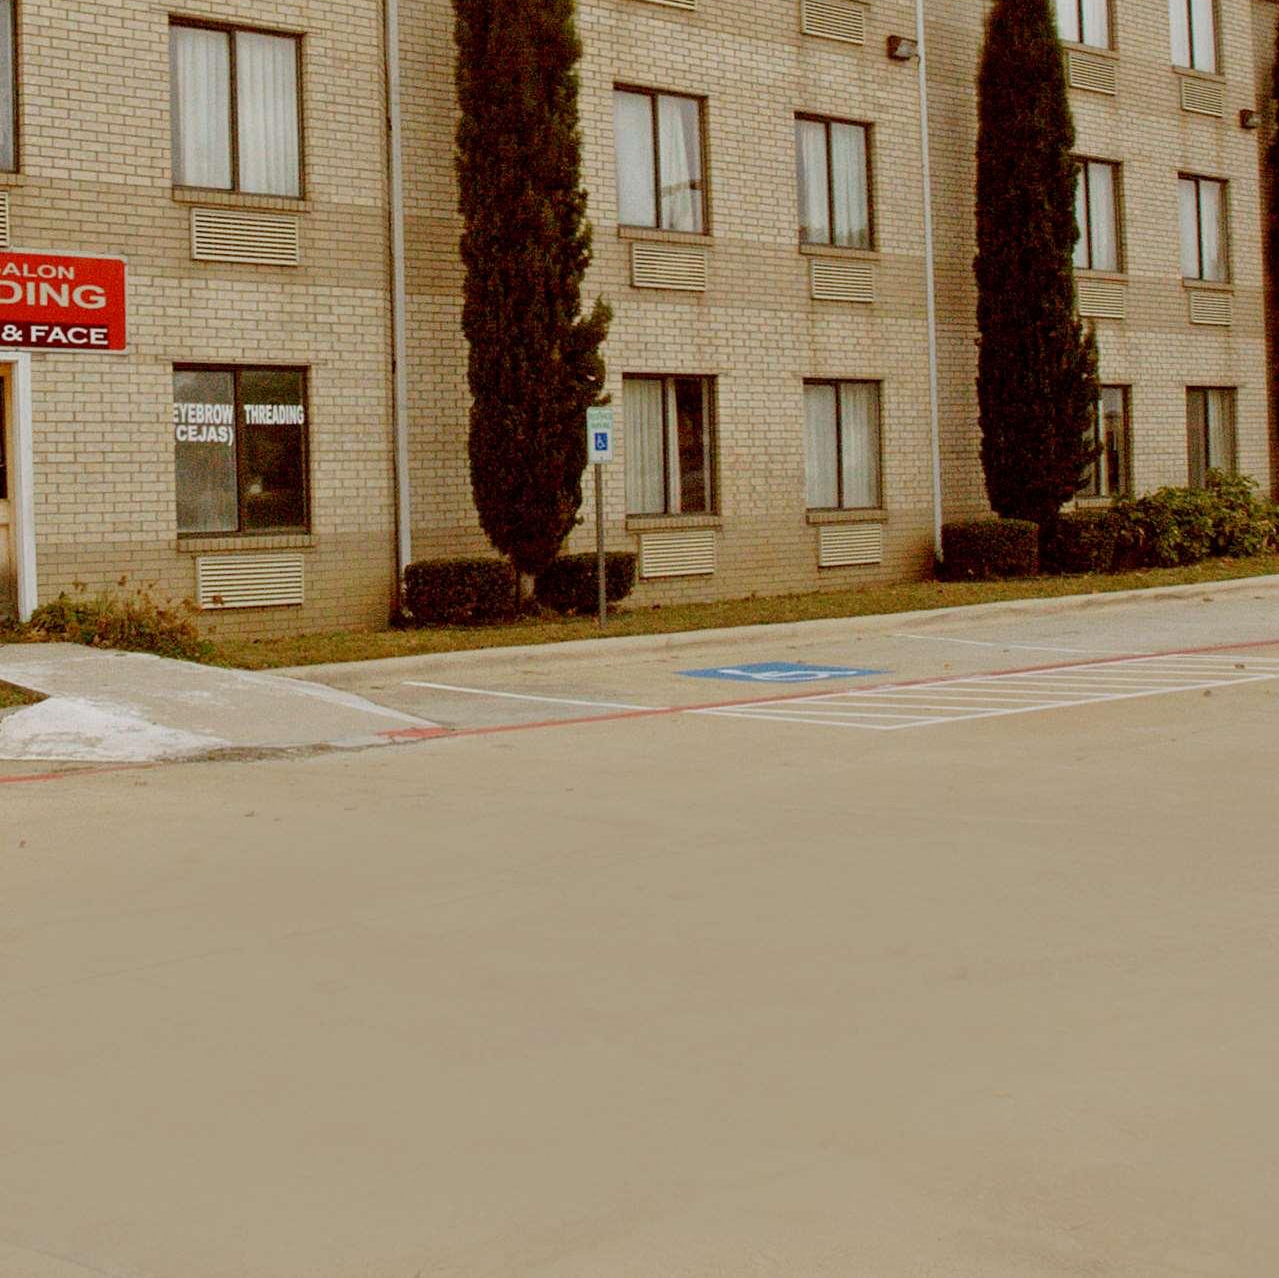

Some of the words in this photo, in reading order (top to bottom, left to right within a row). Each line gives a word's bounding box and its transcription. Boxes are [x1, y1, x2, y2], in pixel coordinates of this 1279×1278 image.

[2, 324, 22, 341] &
[31, 326, 107, 345] FACE
[173, 403, 233, 424] EYEBROW
[244, 404, 304, 424] THREADING
[175, 425, 234, 446] CEJAS)
